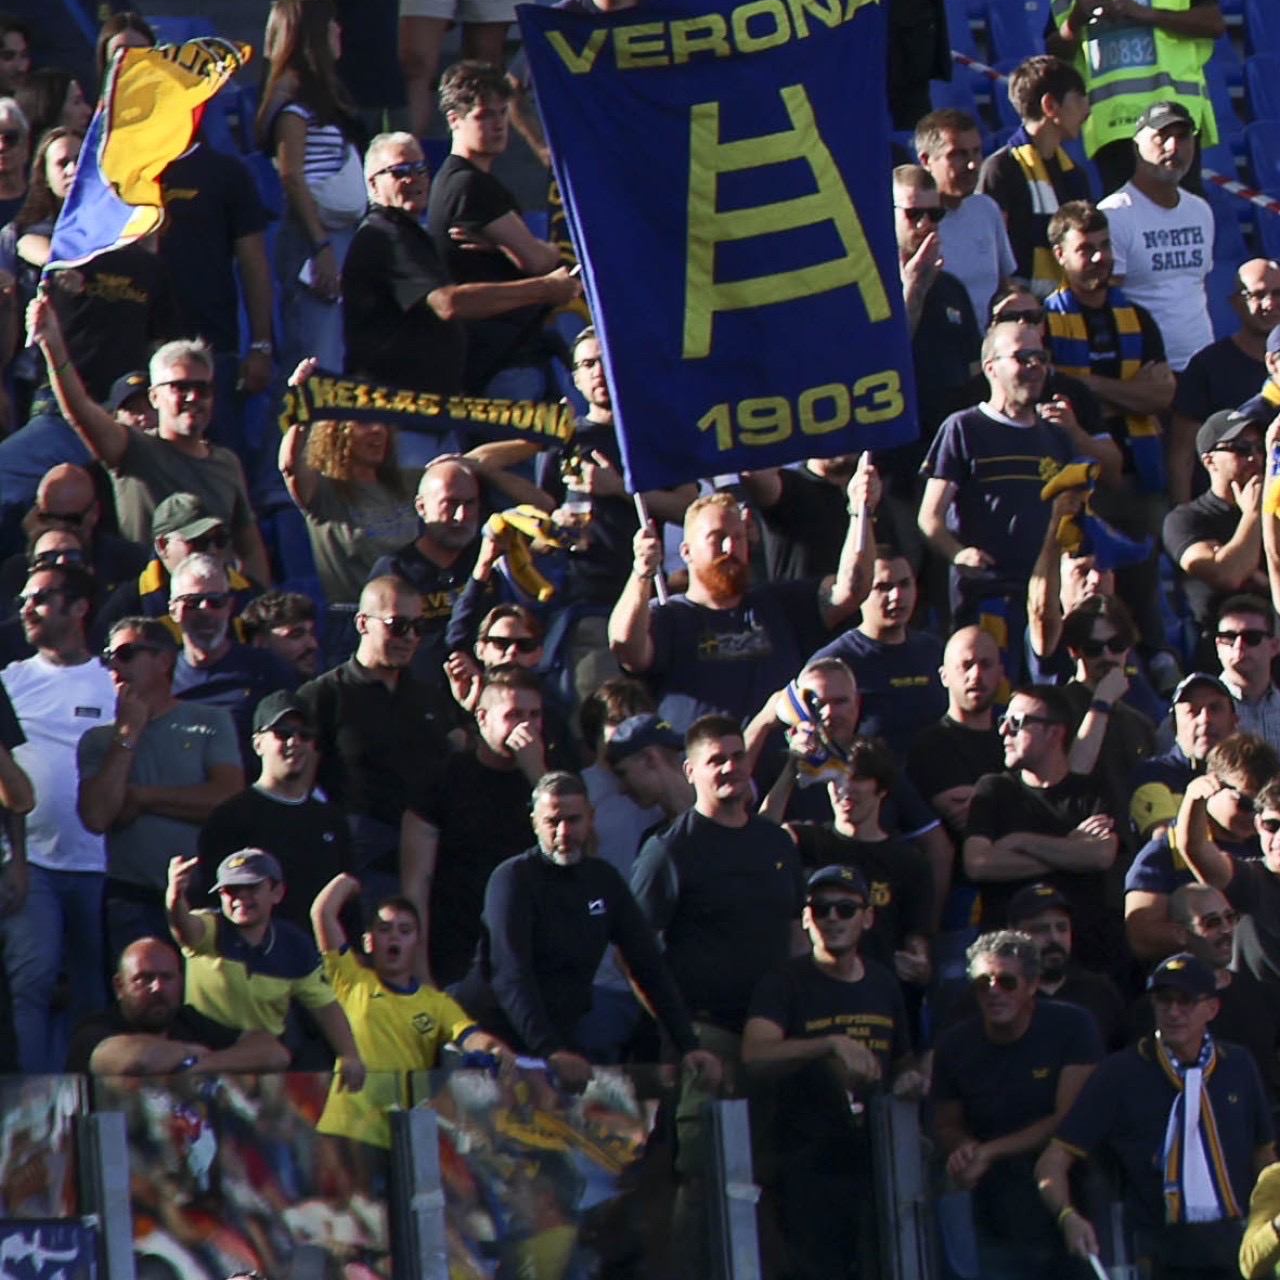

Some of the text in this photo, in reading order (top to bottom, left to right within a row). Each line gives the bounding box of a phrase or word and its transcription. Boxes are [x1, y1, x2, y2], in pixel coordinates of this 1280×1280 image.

[1142, 226, 1204, 249] NORTH
[1151, 250, 1204, 272] SAILS
[697, 369, 905, 451] 1903
